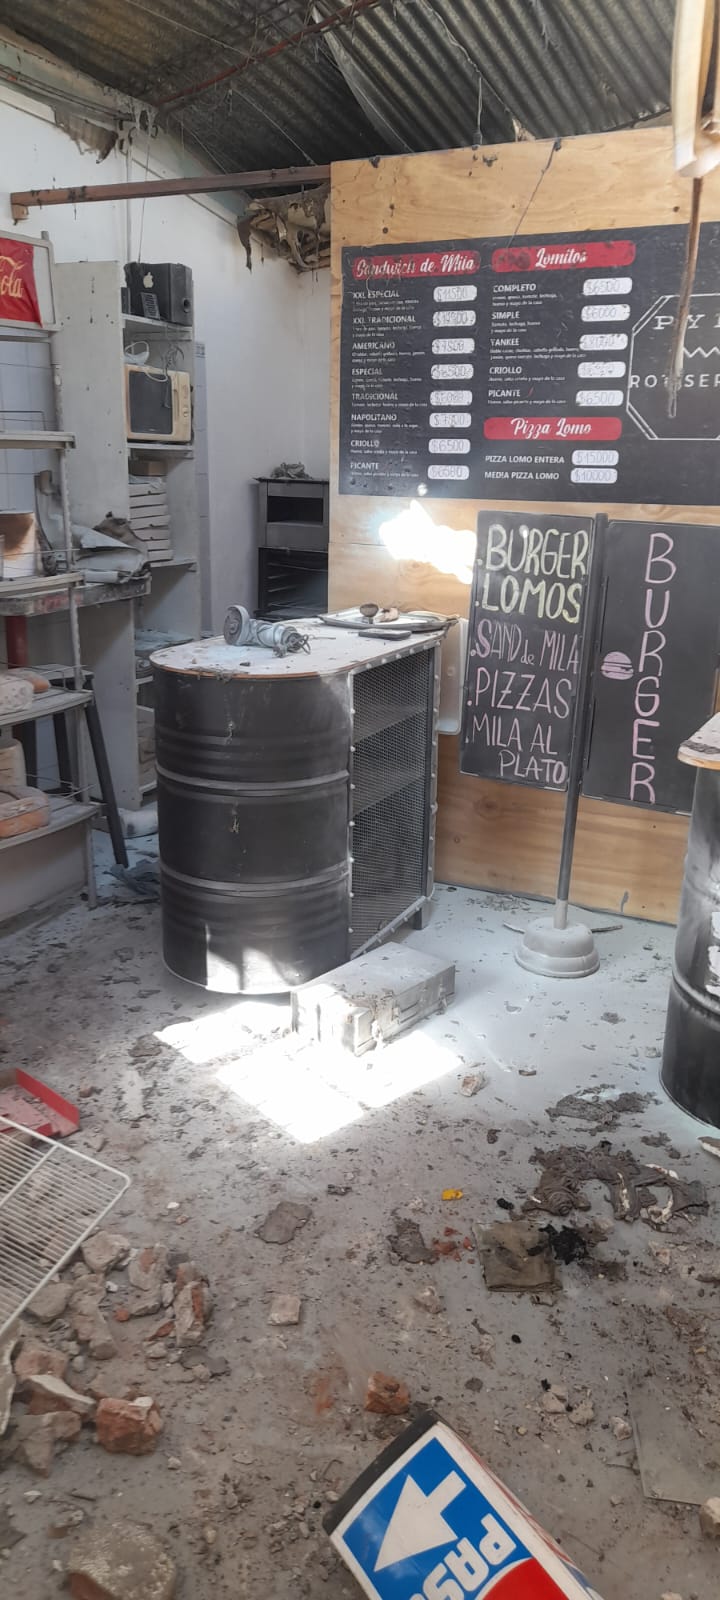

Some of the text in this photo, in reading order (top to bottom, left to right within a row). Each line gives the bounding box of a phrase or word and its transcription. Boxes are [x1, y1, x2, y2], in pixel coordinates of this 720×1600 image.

[420, 258, 436, 273] de
[440, 254, 475, 273] Mila
[535, 247, 588, 268] Lomitos
[493, 283, 537, 293] COMPLETO
[491, 311, 520, 320] SIMPLE
[352, 341, 396, 350] AMERICANO
[490, 337, 520, 347] YANKEE
[351, 368, 383, 376] ESPECIAL
[489, 366, 522, 375] CRIOLLO
[352, 393, 399, 401] TRADICIONAL
[488, 389, 521, 398] PICANTE
[351, 413, 397, 422] NAPOLITANO
[511, 417, 592, 440] Pizza Lomo
[351, 440, 380, 448] CRIOLLO
[485, 455, 565, 464] PIZZA LOMO ENTERA
[576, 450, 615, 465] $15000
[485, 471, 560, 480] MEDIA PIZZA LOMO
[485, 523, 589, 580] BURGER
[481, 573, 583, 624] LOMOS
[475, 618, 580, 675] SAND de MILA
[629, 532, 677, 805] BURGER
[475, 666, 572, 719] PIZZAS
[472, 713, 558, 756] MILA AL
[499, 750, 567, 785] PLATO
[409, 1513, 517, 1600] PAS
